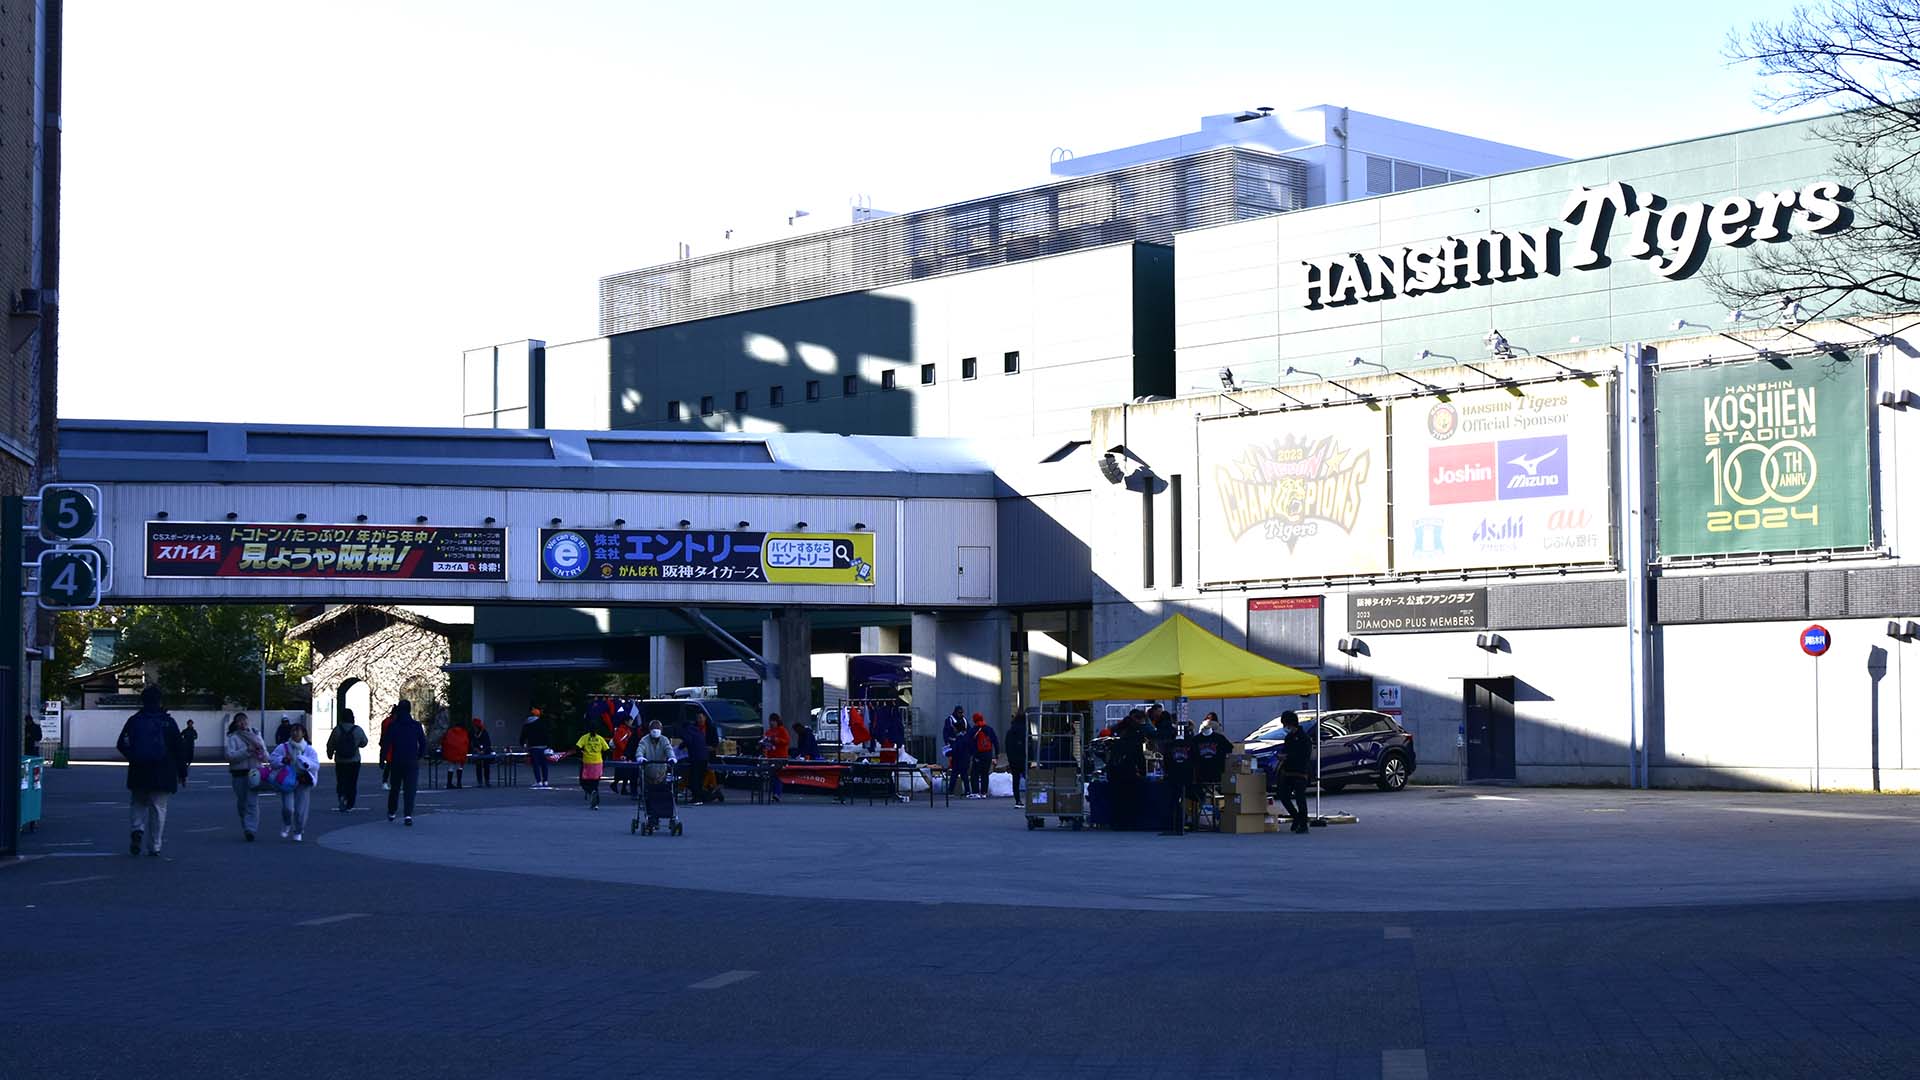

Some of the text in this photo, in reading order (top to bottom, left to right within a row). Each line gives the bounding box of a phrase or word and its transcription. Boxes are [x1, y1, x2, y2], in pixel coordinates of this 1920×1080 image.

[1302, 181, 1854, 310] HANSHIN Tigers
[1725, 380, 1793, 393] HANSHIN
[1462, 395, 1568, 415] HANSHIN Tigers
[1704, 387, 1816, 433] KOSHIEN
[1462, 417, 1510, 433] Official
[1514, 413, 1569, 430] Sponsor
[1704, 425, 1816, 446] STADIUM
[1278, 448, 1303, 462] 2023
[1434, 464, 1492, 485] Joshin
[1779, 472, 1807, 487] ANNIV.
[1215, 448, 1370, 543] CHAMPIONS
[58, 497, 80, 529] 5
[1706, 504, 1819, 533] 2024
[1264, 519, 1318, 541] Tigers
[1472, 515, 1524, 542] Asahi
[1546, 509, 1593, 530] au
[153, 533, 222, 542] CSスポーツチャンネル
[547, 539, 558, 550] We
[556, 534, 568, 542] can
[569, 535, 579, 543] do
[771, 542, 831, 553] バイトするなら
[1542, 534, 1600, 551] じぶん銀行
[157, 544, 219, 560] スカイA
[239, 543, 412, 572] 見ようや阪神!
[554, 540, 578, 567] e
[624, 533, 761, 563] エントリー
[771, 554, 831, 566] エントリー
[51, 563, 78, 596] 4
[552, 566, 581, 577] ENTRY
[618, 565, 659, 577] がんばれ
[662, 564, 760, 579] 阪神タイガース
[1356, 592, 1475, 607] 阪神タイガース 公式ファンクラブ
[1356, 616, 1475, 630] DIAMOND PLUS MEMBERS
